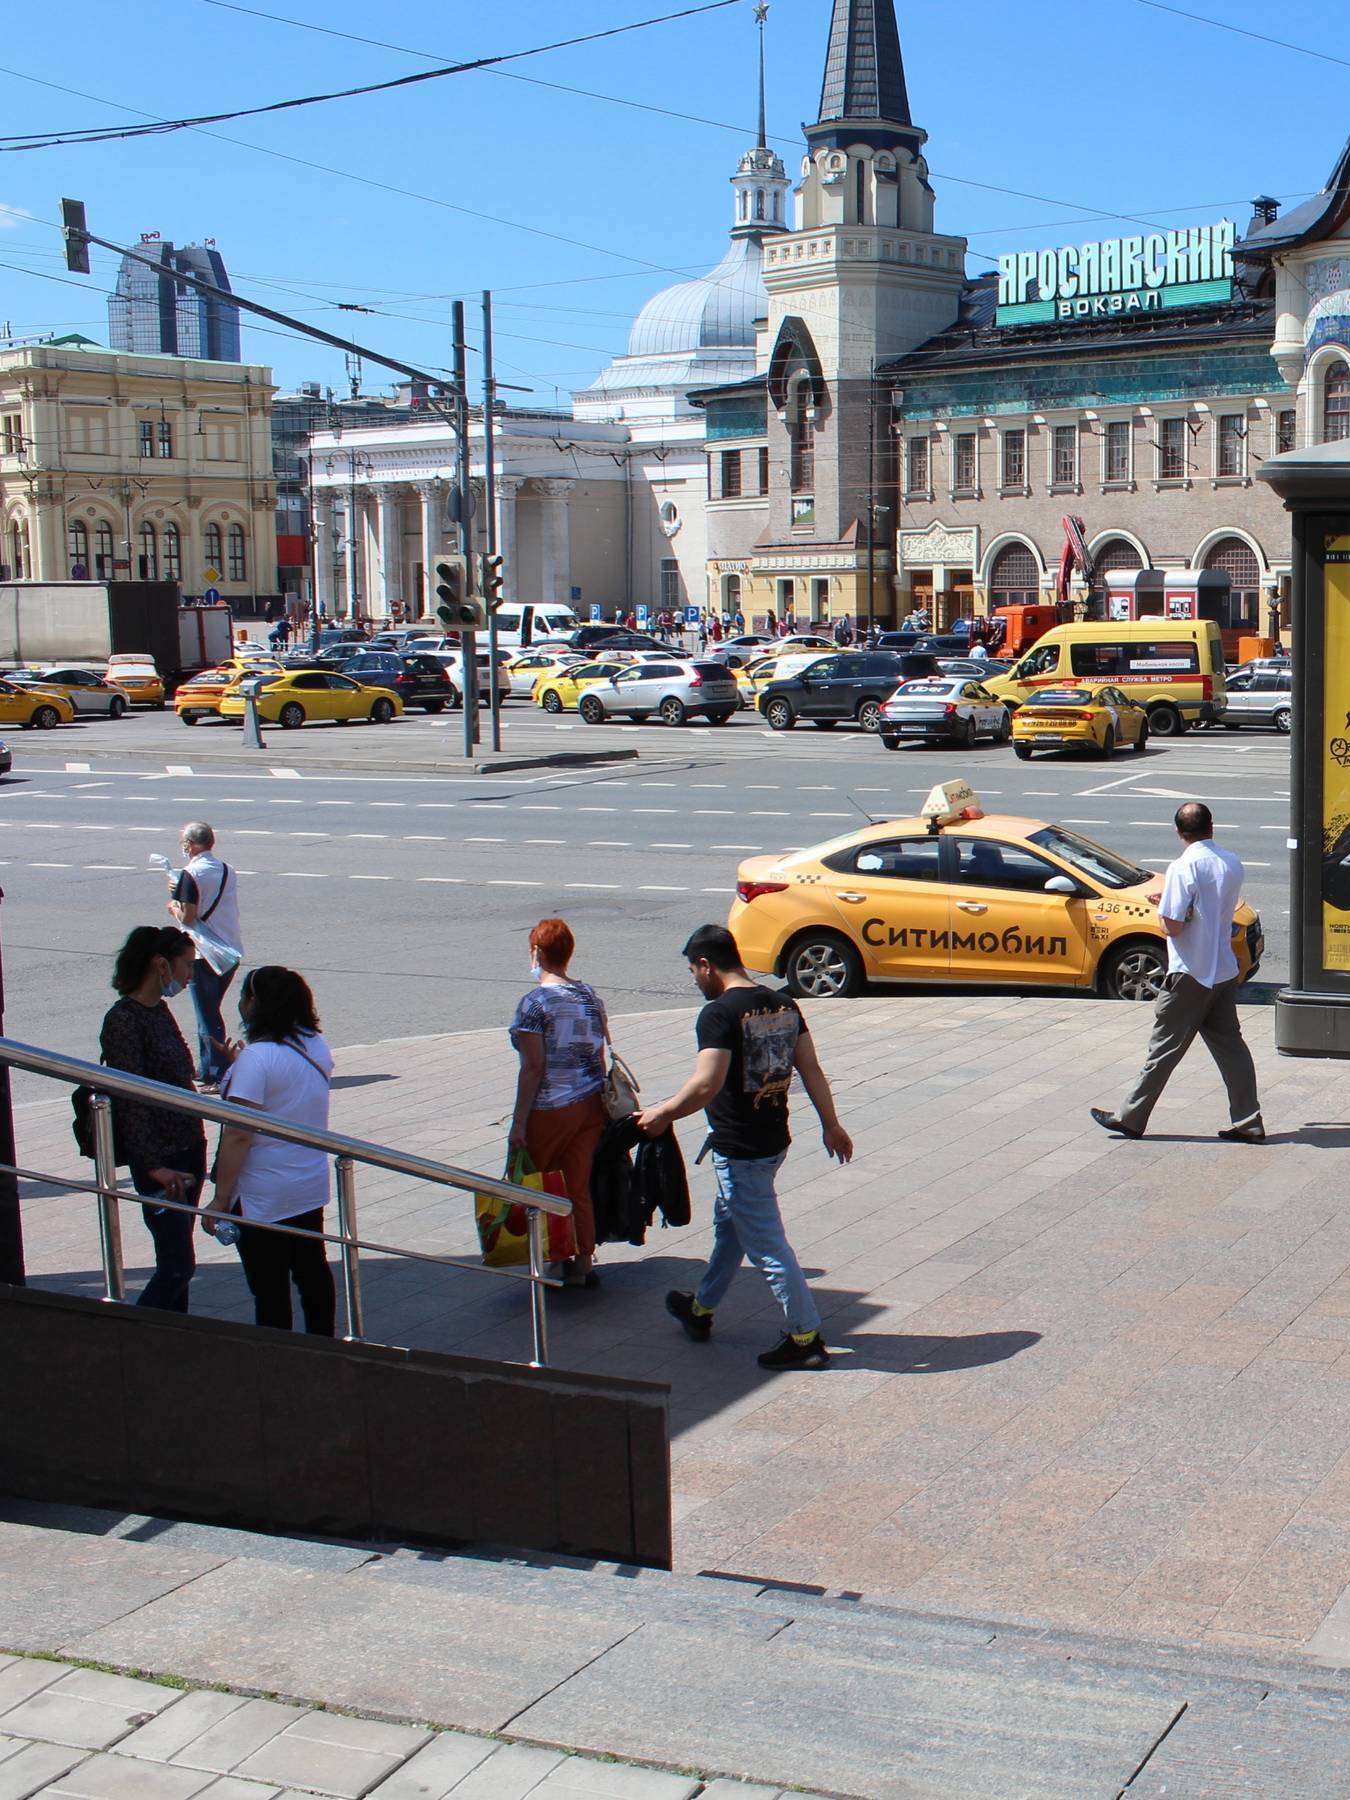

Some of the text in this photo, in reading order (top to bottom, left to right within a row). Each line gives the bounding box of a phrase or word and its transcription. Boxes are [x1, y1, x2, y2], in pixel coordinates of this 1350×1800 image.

[998, 216, 1237, 305] ЯРОСЛАВСКИЙ
[1059, 290, 1161, 317] ВОКЗАЛ
[591, 606, 598, 619] P
[638, 606, 645, 619] P
[688, 607, 697, 621] P
[1097, 902, 1120, 914] 436
[861, 918, 1067, 956] Ситимобил
